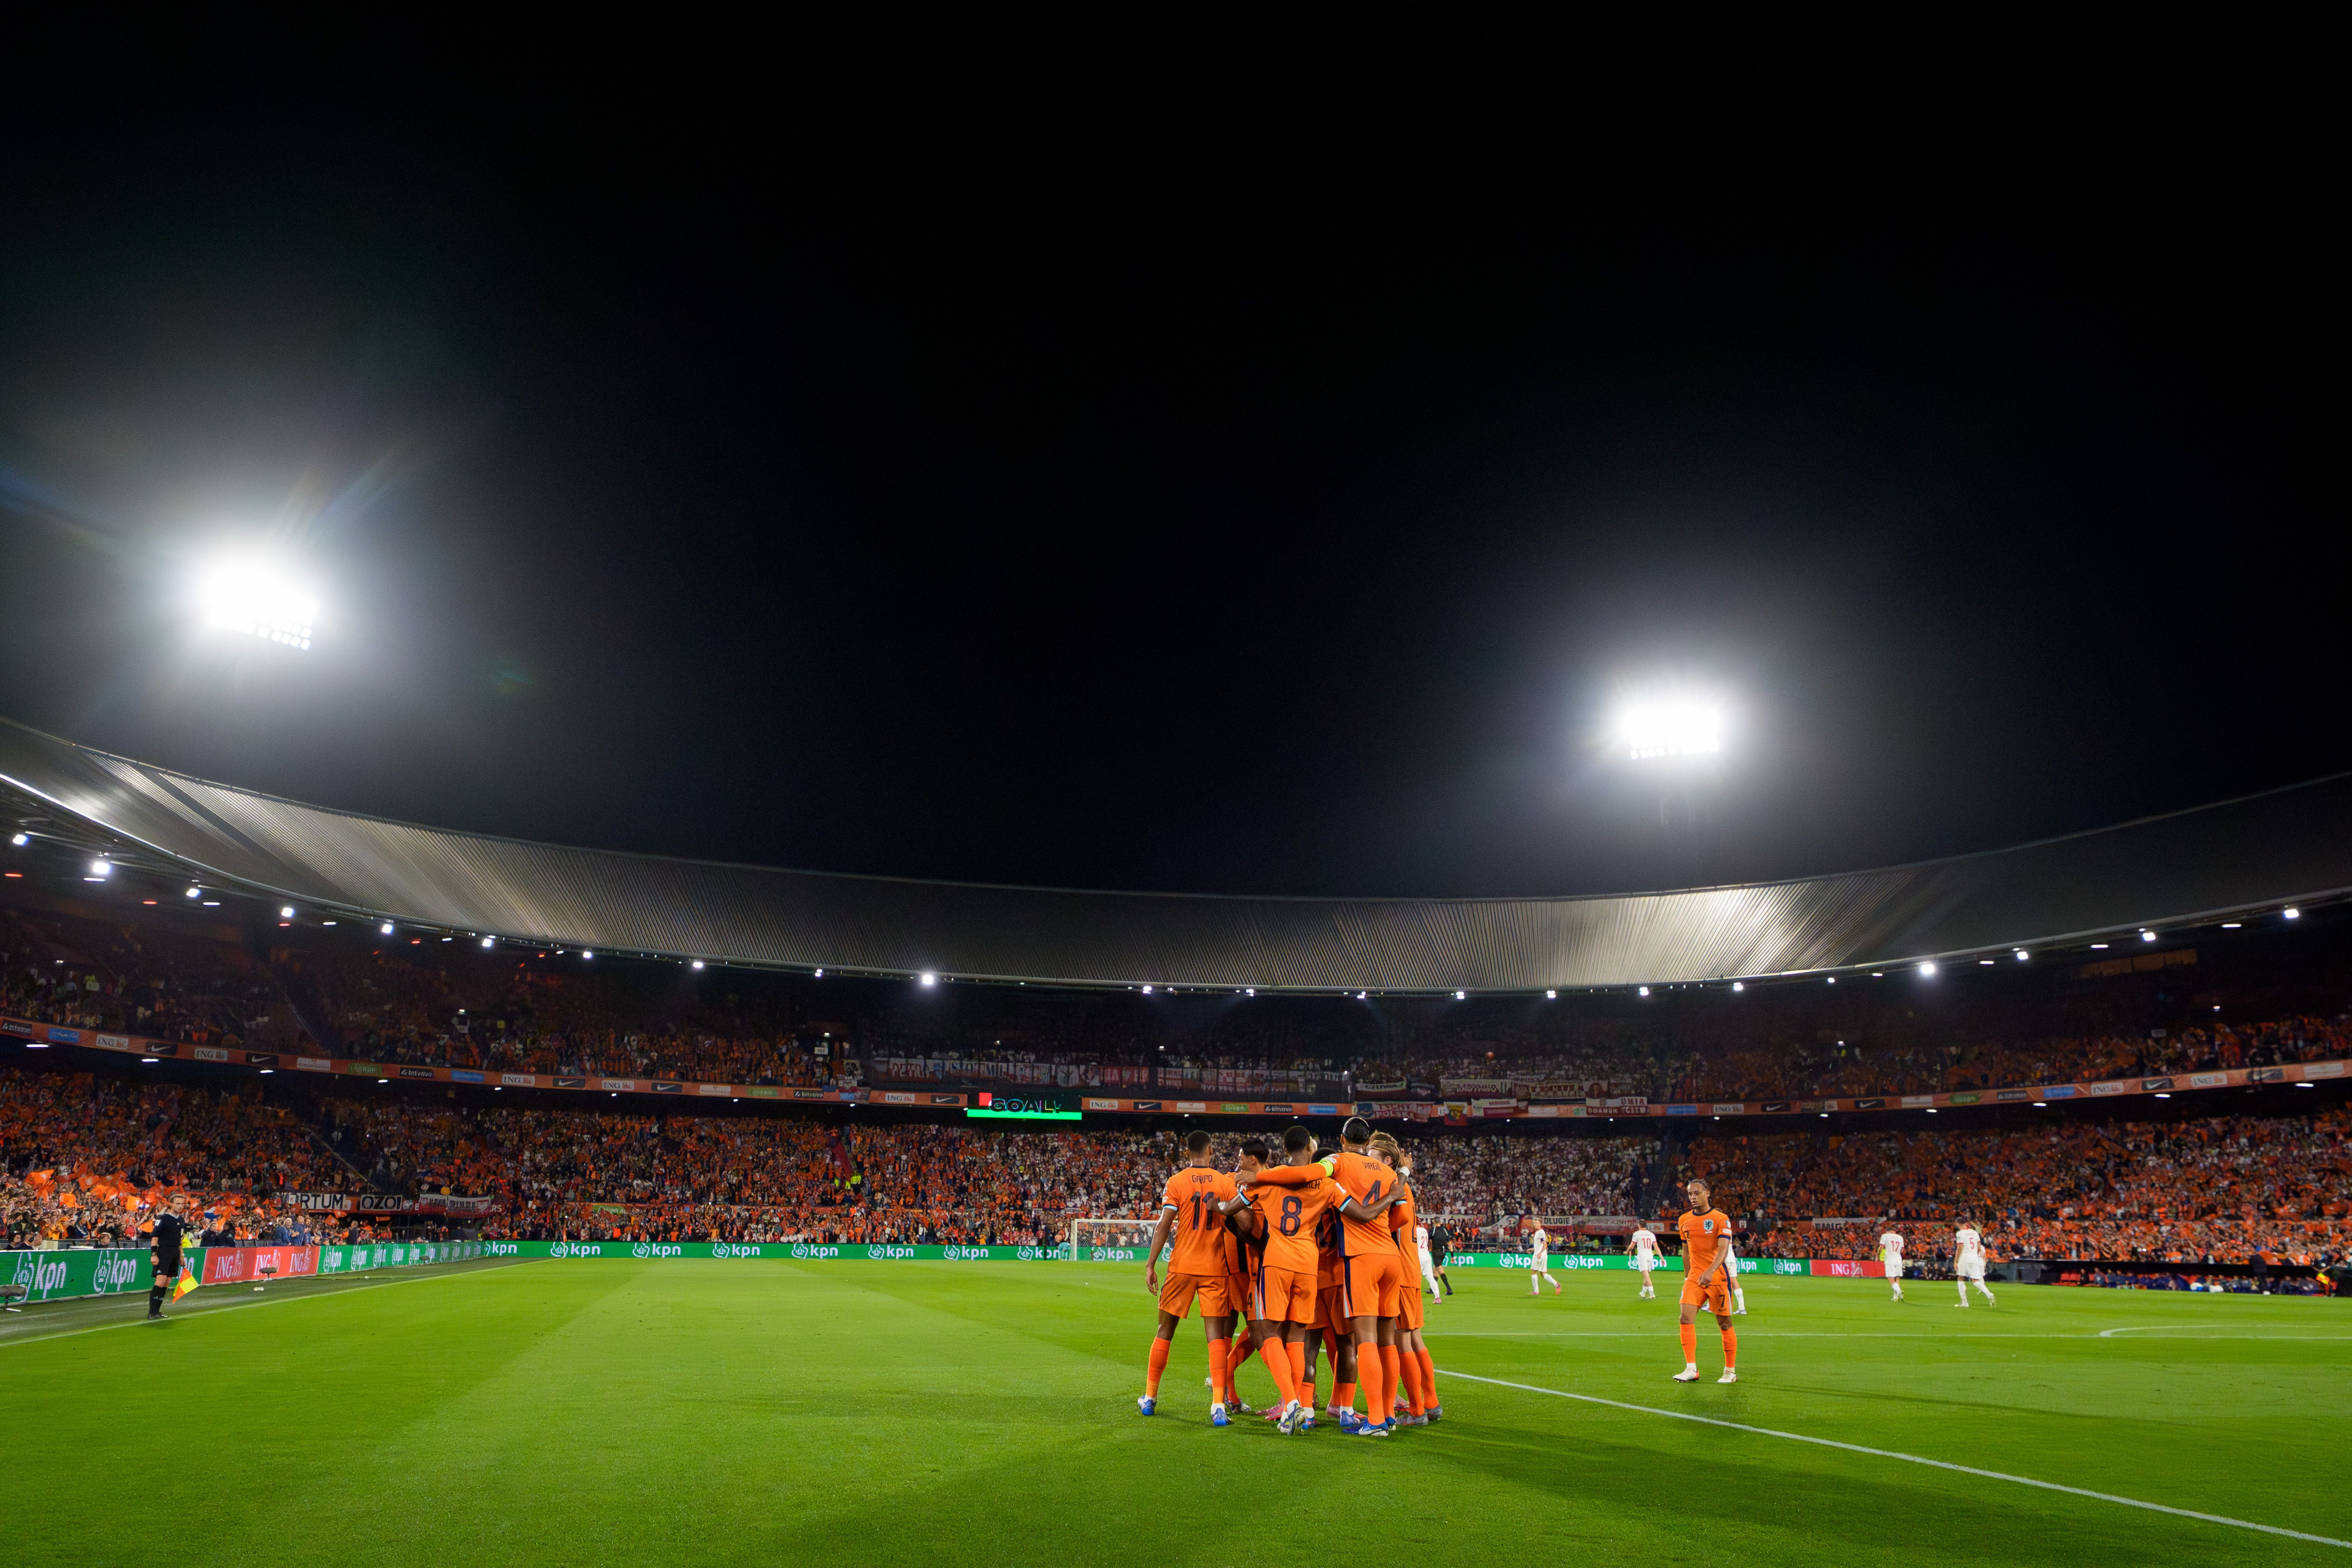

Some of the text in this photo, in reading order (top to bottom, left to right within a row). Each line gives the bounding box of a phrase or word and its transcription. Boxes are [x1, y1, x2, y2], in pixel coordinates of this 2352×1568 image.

[196, 1049, 214, 1059] ING
[1362, 1161, 1382, 1171] VIRGIL
[1362, 1180, 1381, 1207] 4
[1191, 1191, 1215, 1231] 11
[1280, 1196, 1302, 1236] 8
[492, 1241, 517, 1256] kpn
[1421, 1236, 1429, 1249] 21
[1642, 1238, 1651, 1249] 10
[1891, 1241, 1900, 1252] 17
[1970, 1238, 1974, 1249] 5
[358, 1245, 367, 1270] kpn
[571, 1243, 600, 1258] kpn
[652, 1243, 681, 1258] kpn
[732, 1244, 760, 1258] kpn
[811, 1244, 838, 1259] kpn
[887, 1245, 913, 1260] kpn
[962, 1246, 988, 1260] kpn
[1107, 1248, 1133, 1262] kpn
[215, 1255, 234, 1278] ING
[253, 1254, 271, 1275] ING
[289, 1253, 304, 1273] ING
[330, 1246, 342, 1272] kpn
[1580, 1255, 1603, 1268] kpn
[110, 1253, 136, 1292] kpn
[1741, 1261, 1757, 1274] kpn
[1784, 1260, 1801, 1274] kpn
[1831, 1263, 1850, 1275] ING
[34, 1255, 67, 1299] kpn
[1719, 1295, 1725, 1307] 7
